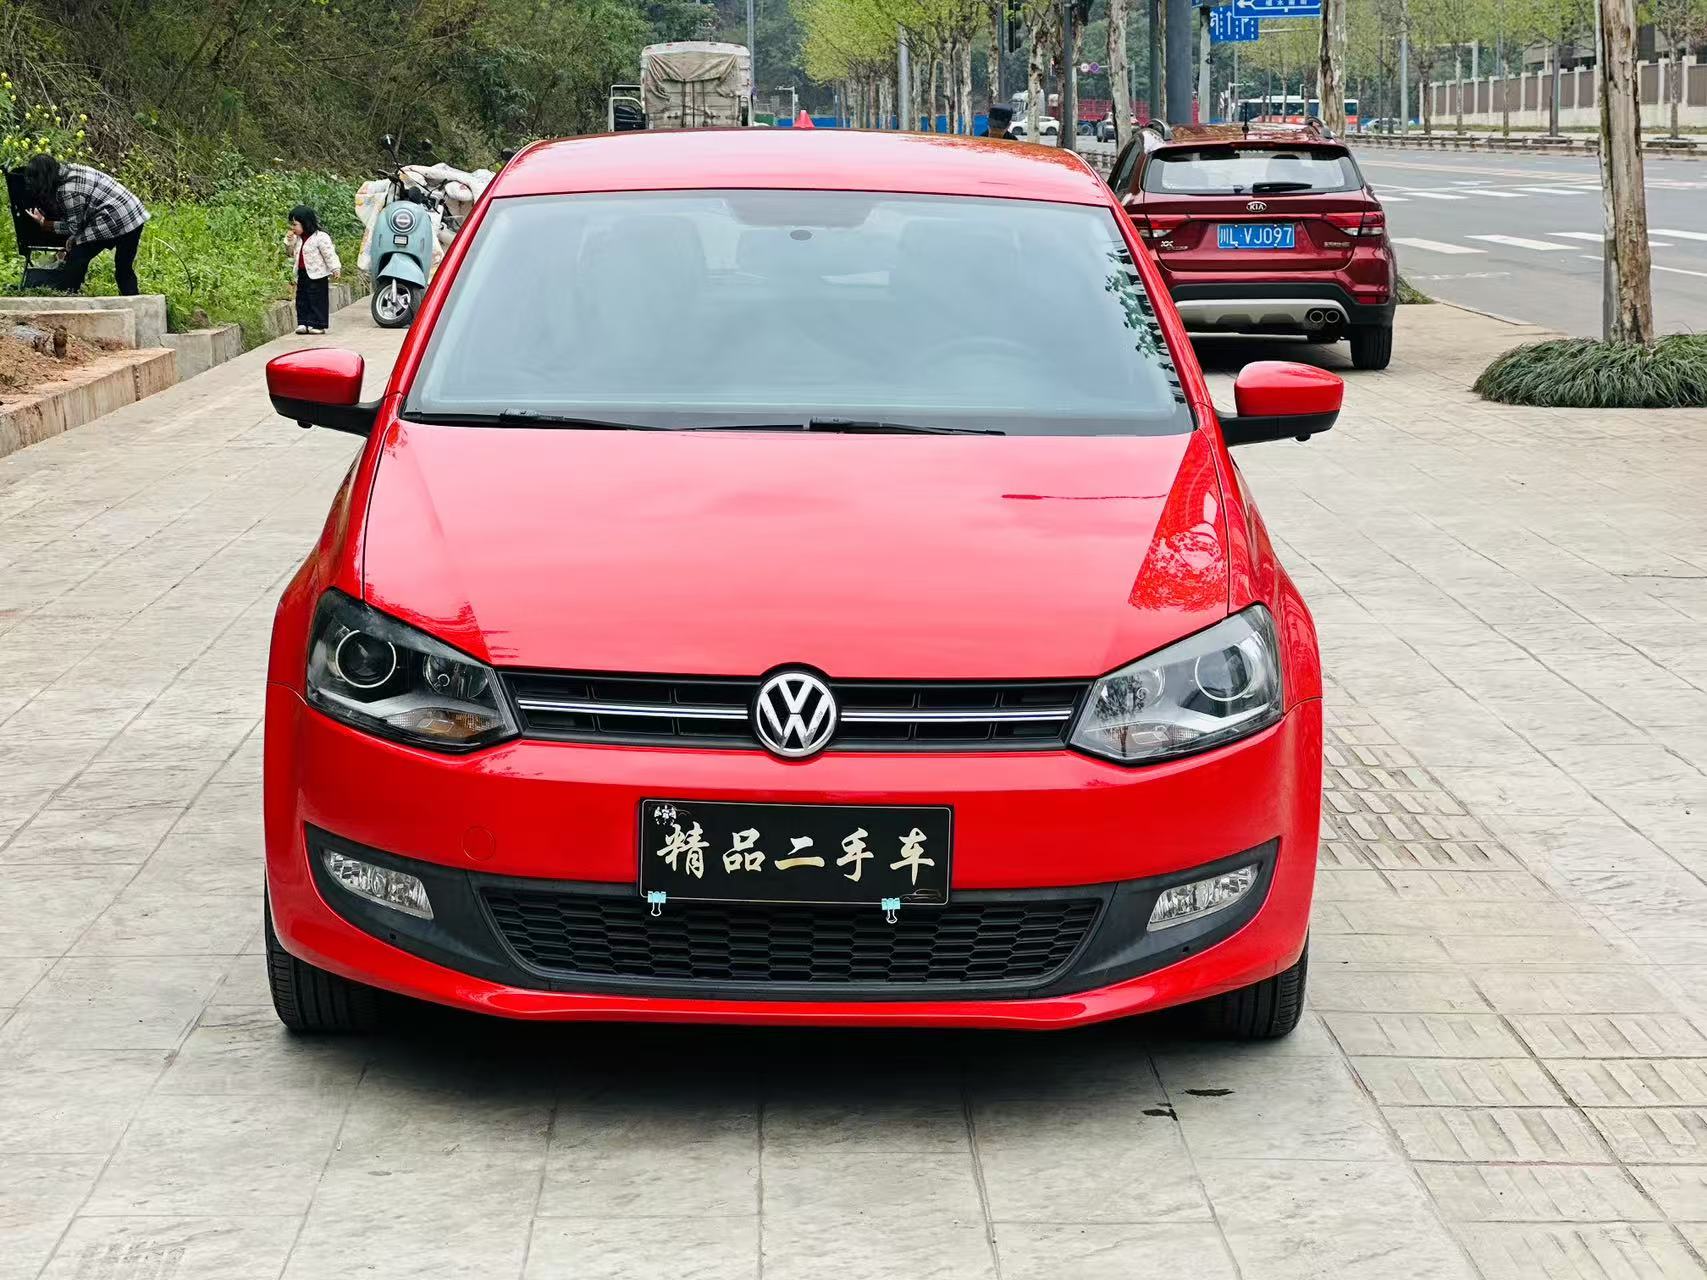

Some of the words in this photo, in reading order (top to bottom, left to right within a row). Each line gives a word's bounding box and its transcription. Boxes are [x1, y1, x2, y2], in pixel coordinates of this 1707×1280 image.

[757, 673, 836, 757] VW
[656, 821, 935, 886] 精品二手车
